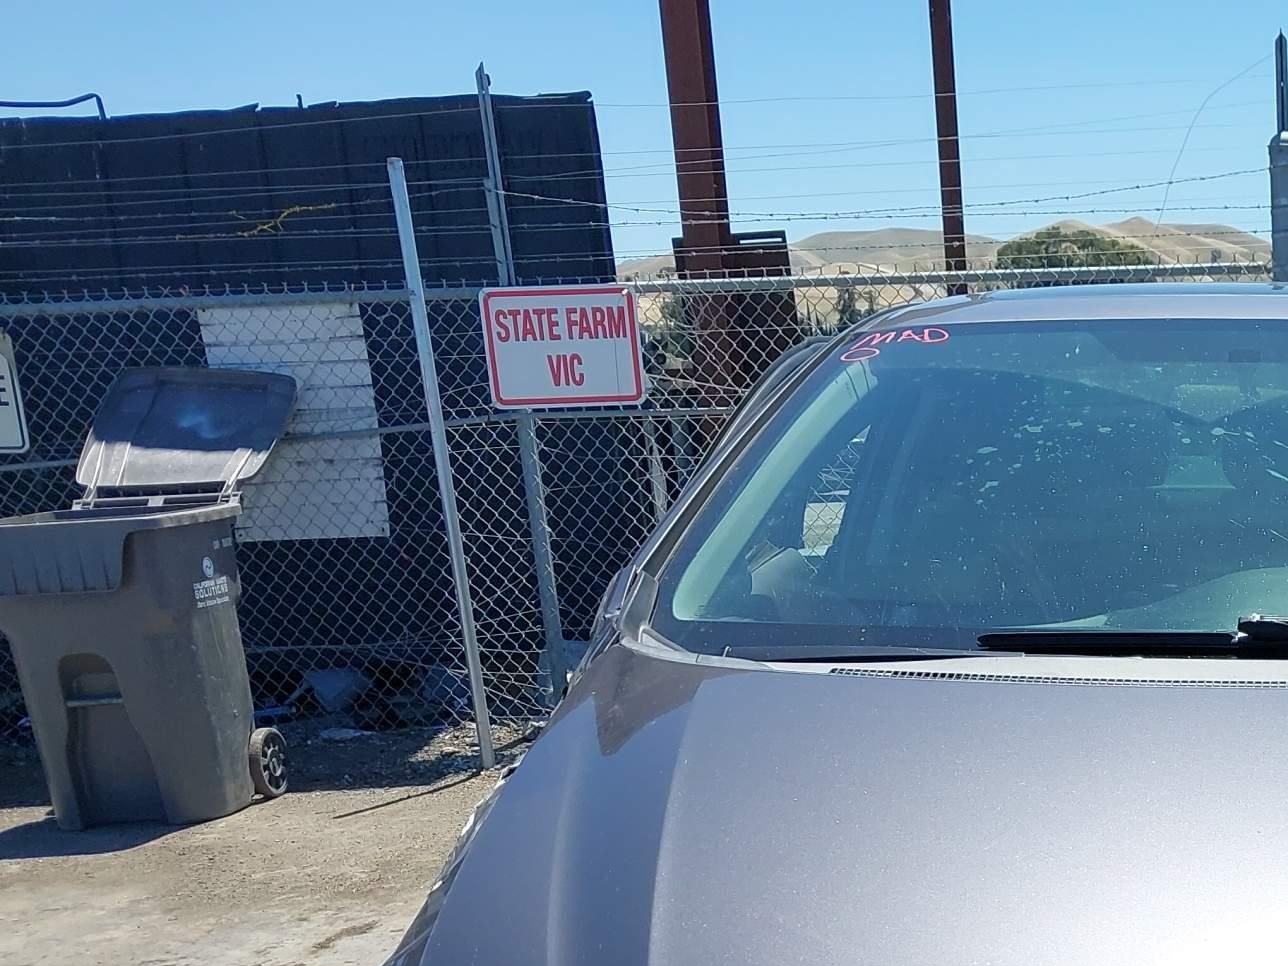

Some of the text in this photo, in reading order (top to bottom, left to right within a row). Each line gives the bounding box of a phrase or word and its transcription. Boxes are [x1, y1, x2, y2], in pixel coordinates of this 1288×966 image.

[494, 305, 628, 343] STATE FARM
[850, 327, 950, 350] MAD
[547, 352, 585, 387] VIC
